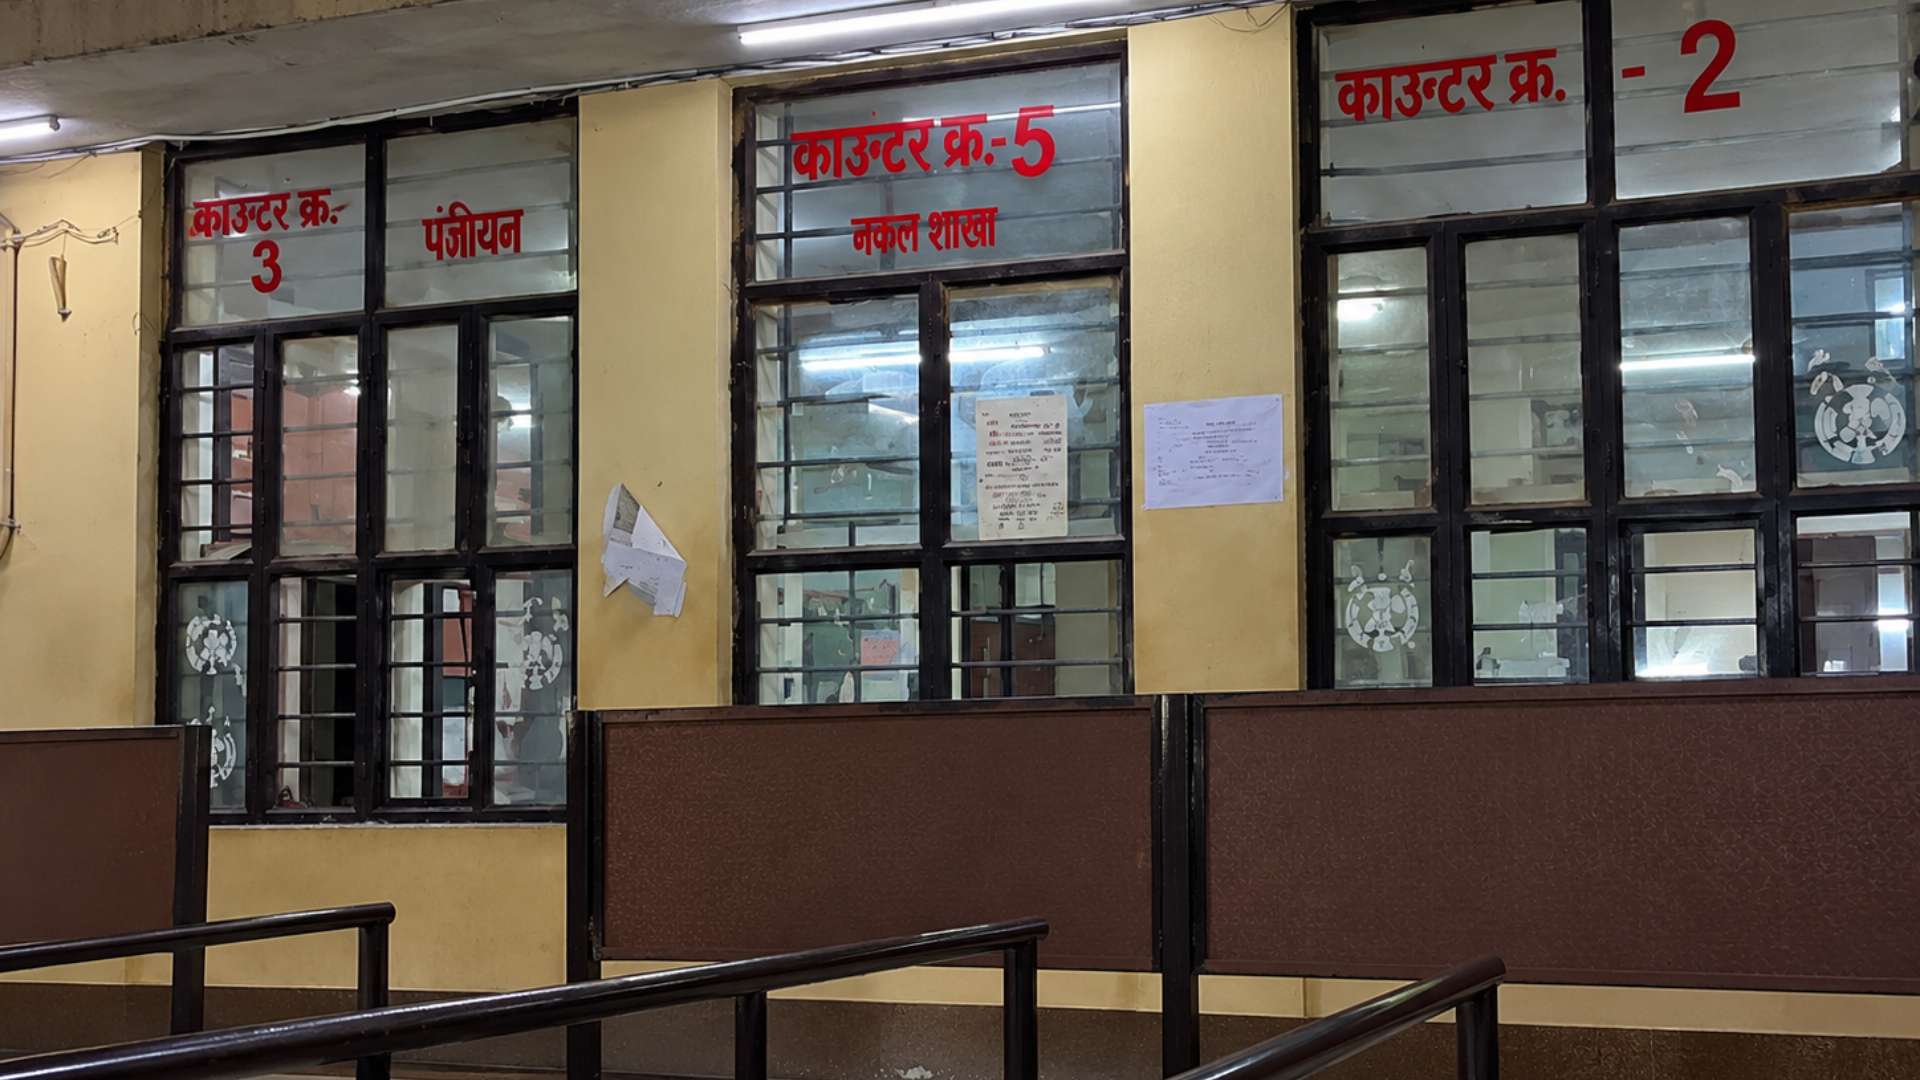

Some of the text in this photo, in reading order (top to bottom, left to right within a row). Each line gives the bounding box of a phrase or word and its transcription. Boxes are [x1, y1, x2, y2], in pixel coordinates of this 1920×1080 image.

[1335, 54, 1498, 122] काउन्टर
[1681, 19, 1741, 113] 2
[422, 201, 524, 261] पंजीयन
[850, 206, 999, 256] नकल शाखा
[251, 239, 282, 294] 3
